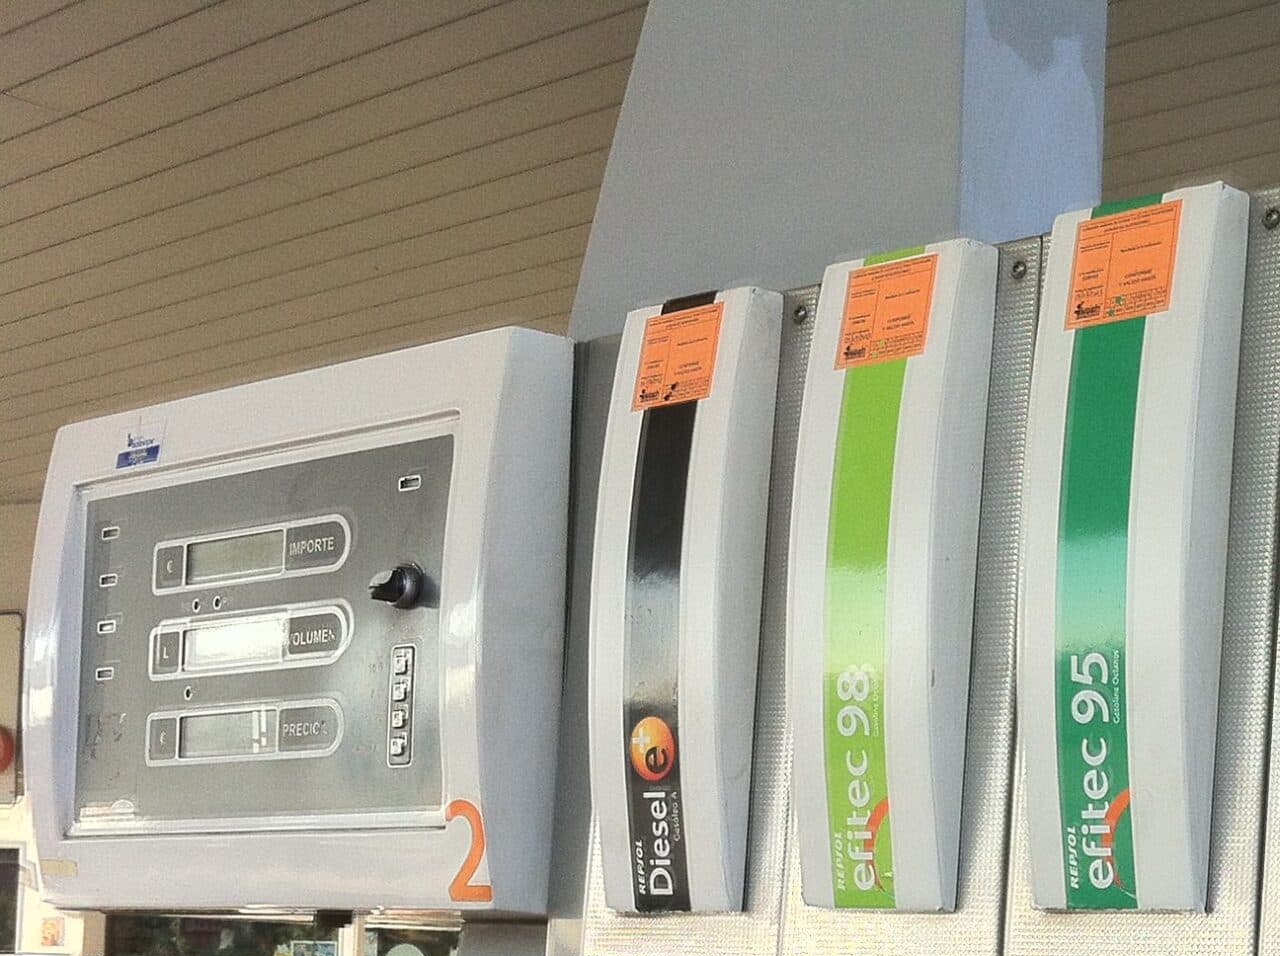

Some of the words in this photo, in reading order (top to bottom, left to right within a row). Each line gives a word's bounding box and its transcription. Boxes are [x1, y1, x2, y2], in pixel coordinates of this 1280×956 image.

[289, 537, 335, 556] IMPORTE
[836, 664, 870, 737] 98
[1070, 652, 1110, 724] 95
[643, 791, 674, 896] Diesel
[846, 750, 876, 891] efitec
[1081, 737, 1115, 889] efitec
[446, 799, 493, 901] 2
[634, 839, 646, 895] REPSOL
[1067, 825, 1079, 889] REPSOL
